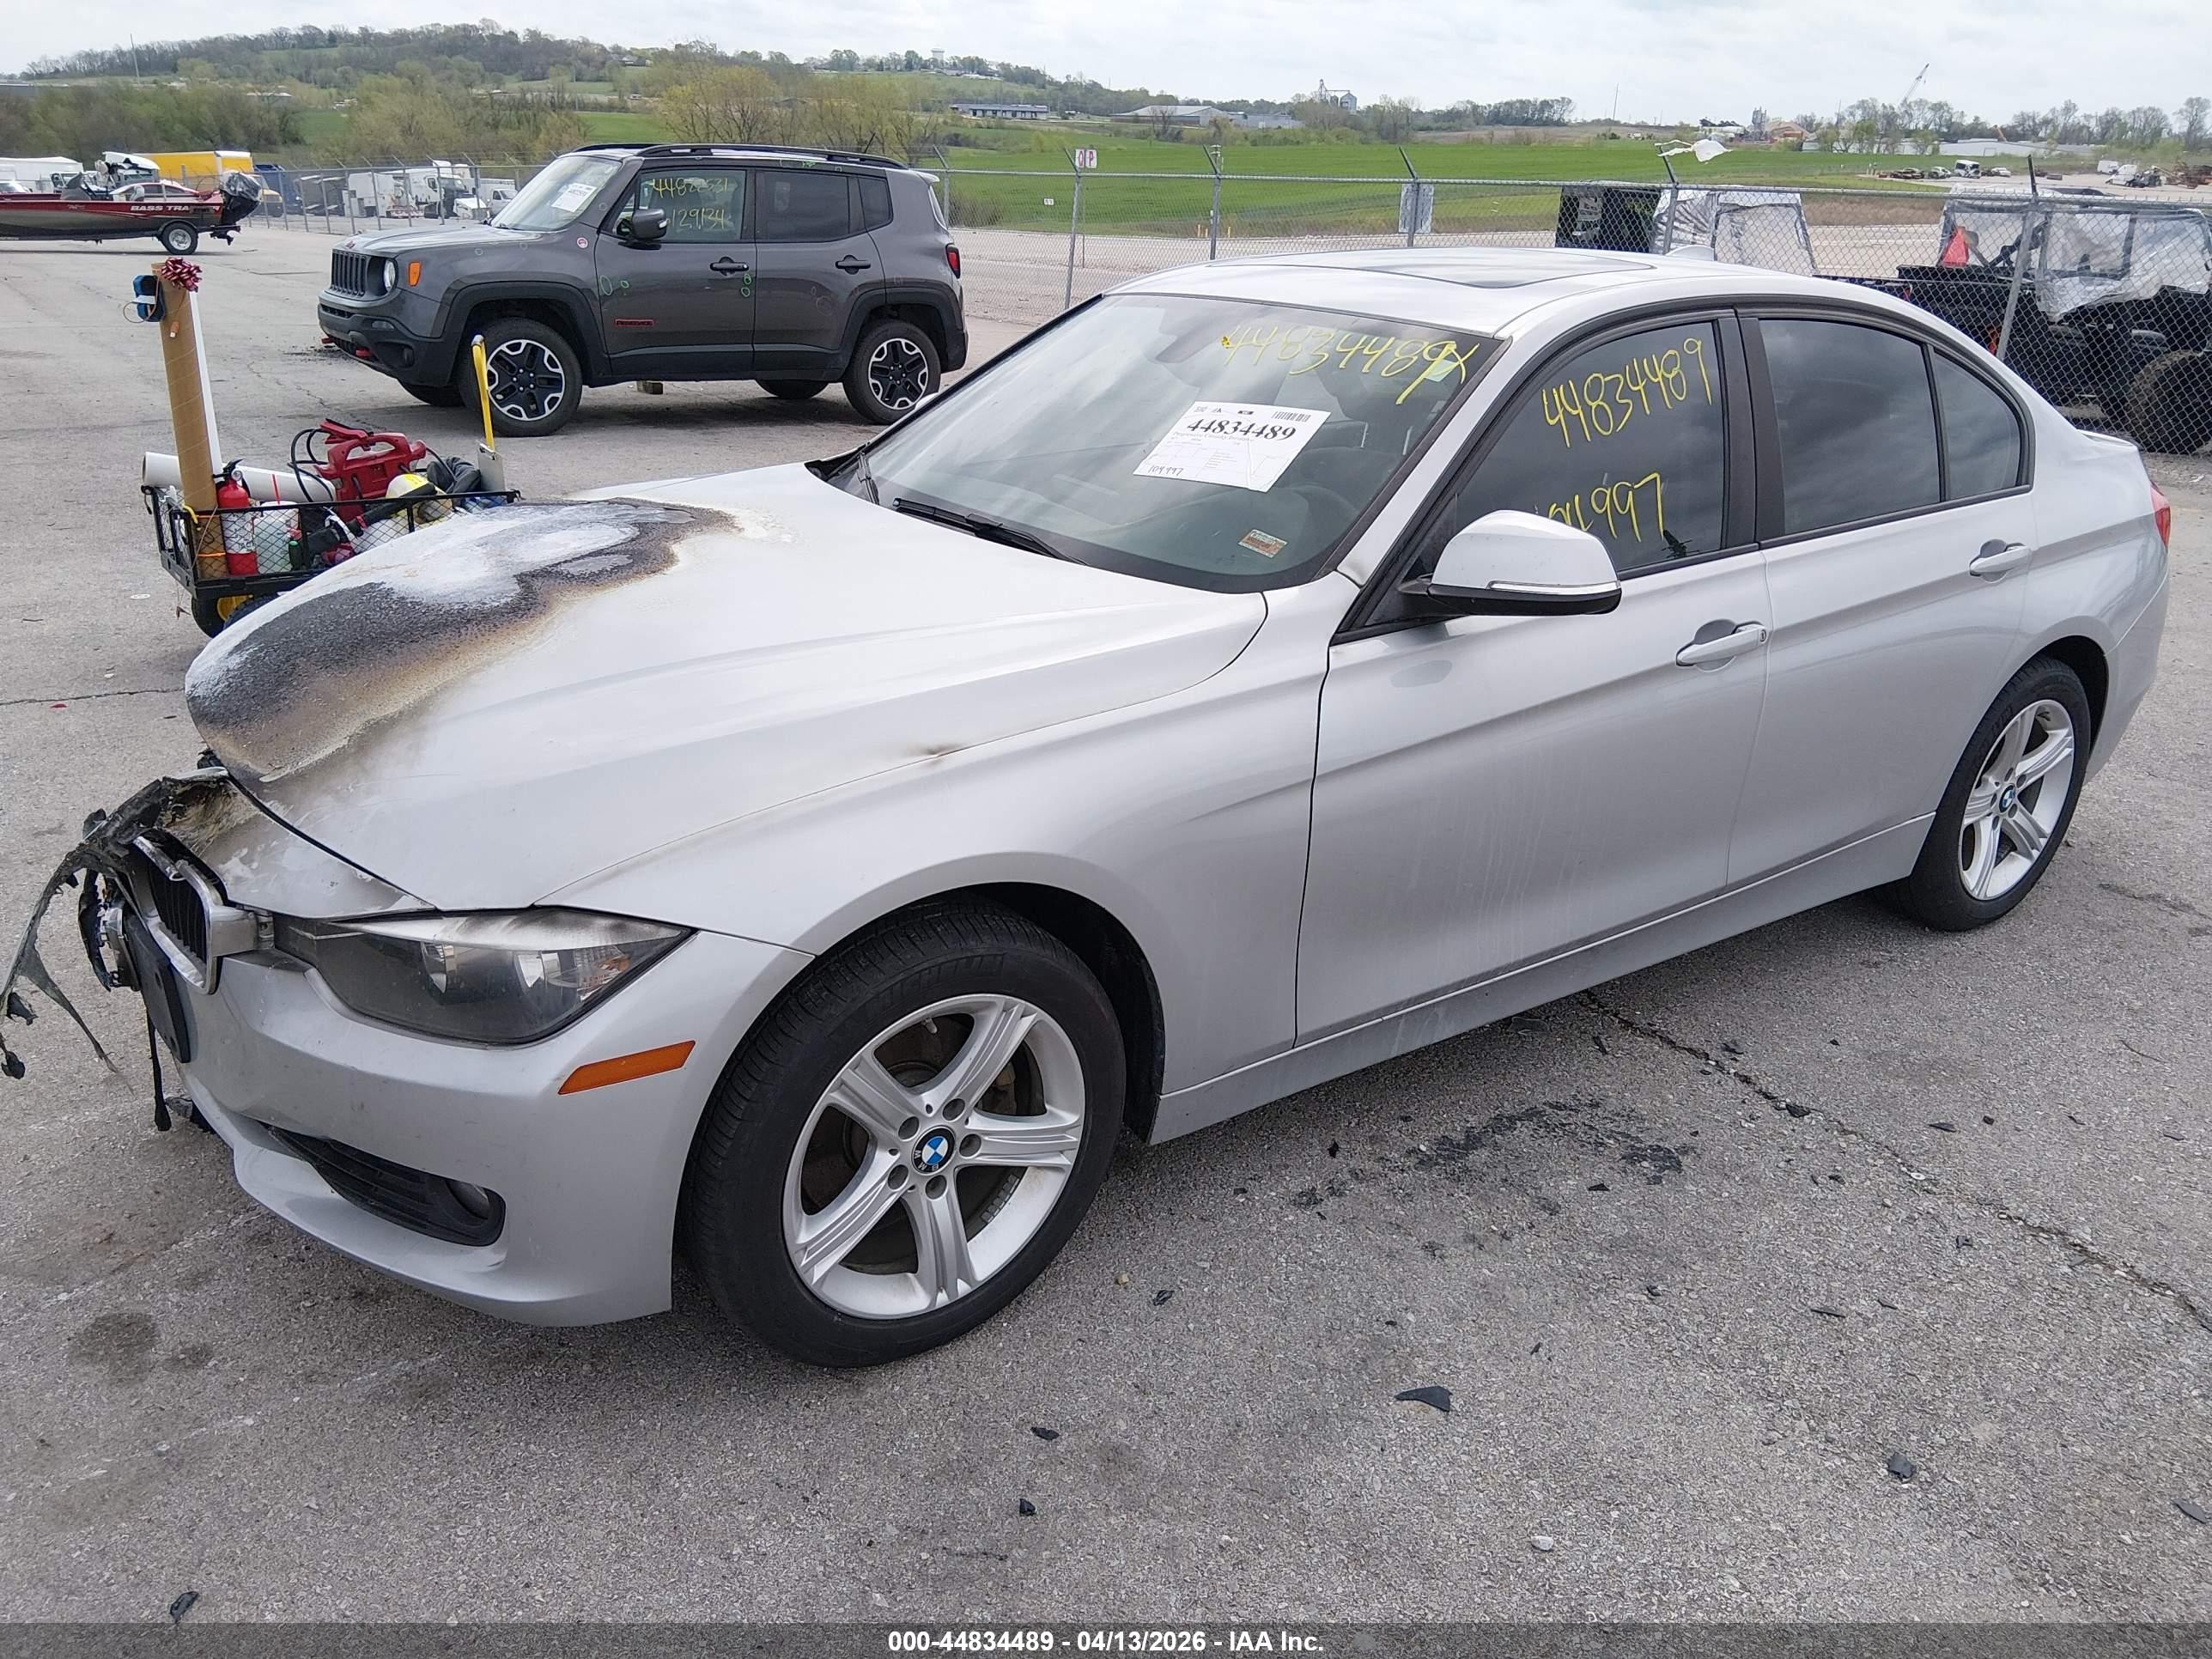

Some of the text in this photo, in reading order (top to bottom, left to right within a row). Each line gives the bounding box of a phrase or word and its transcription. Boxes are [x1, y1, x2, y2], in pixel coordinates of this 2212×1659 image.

[1222, 325, 1456, 405] 44834489
[1542, 337, 1712, 448] 44834489
[1187, 418, 1297, 441] 44834489
[914, 1150, 939, 1171] BMW
